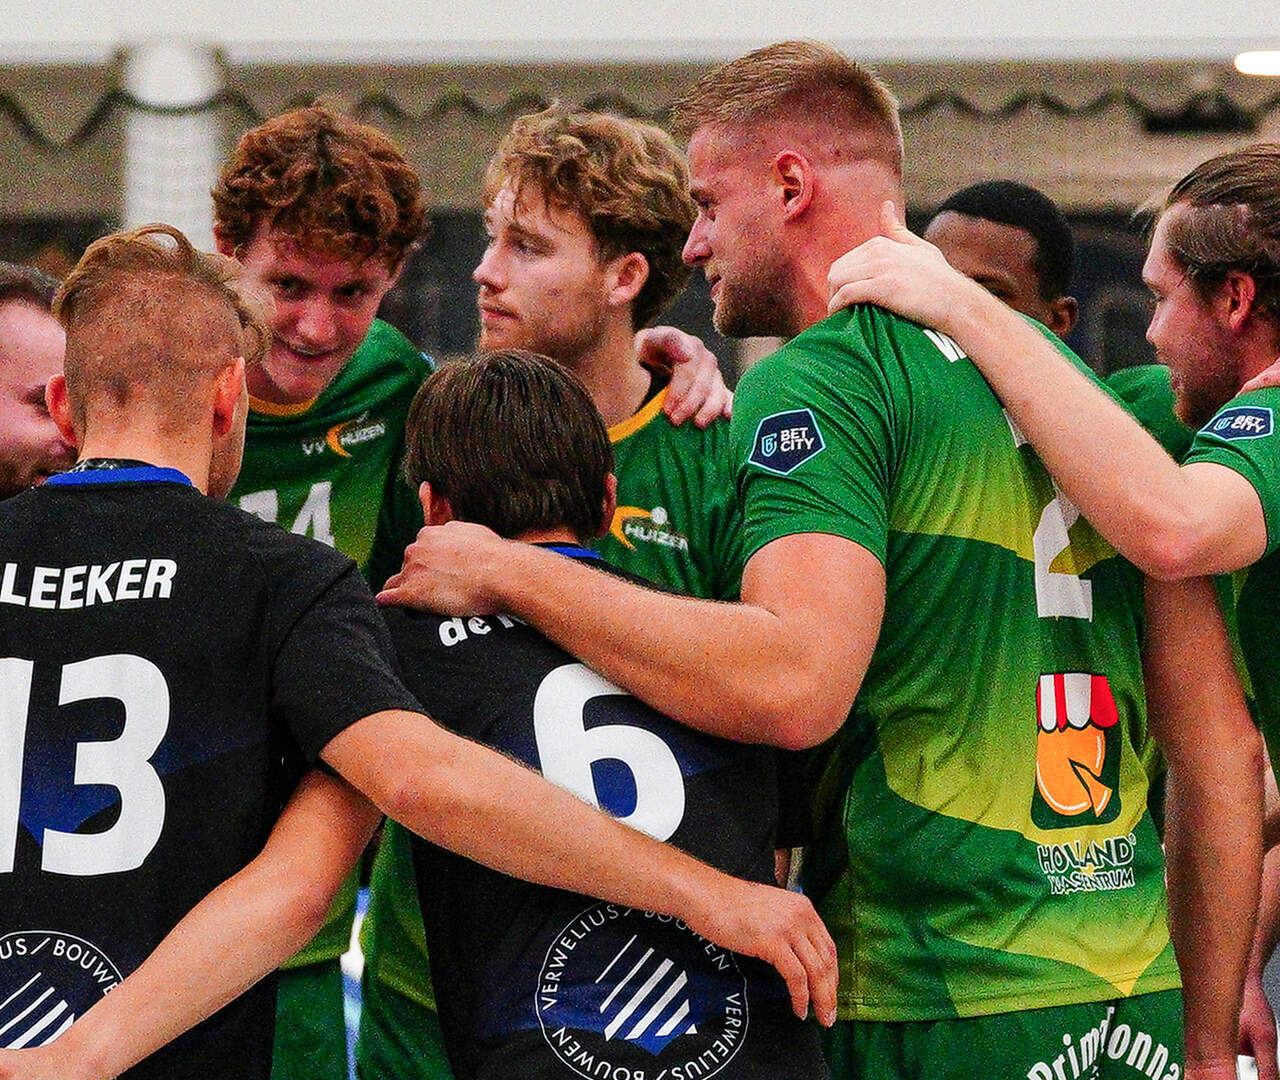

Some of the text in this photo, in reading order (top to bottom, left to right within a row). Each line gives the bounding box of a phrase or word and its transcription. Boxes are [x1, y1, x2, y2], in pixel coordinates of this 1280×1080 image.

[780, 427, 808, 442] BET
[780, 437, 814, 452] CITY
[532, 662, 686, 843] 6
